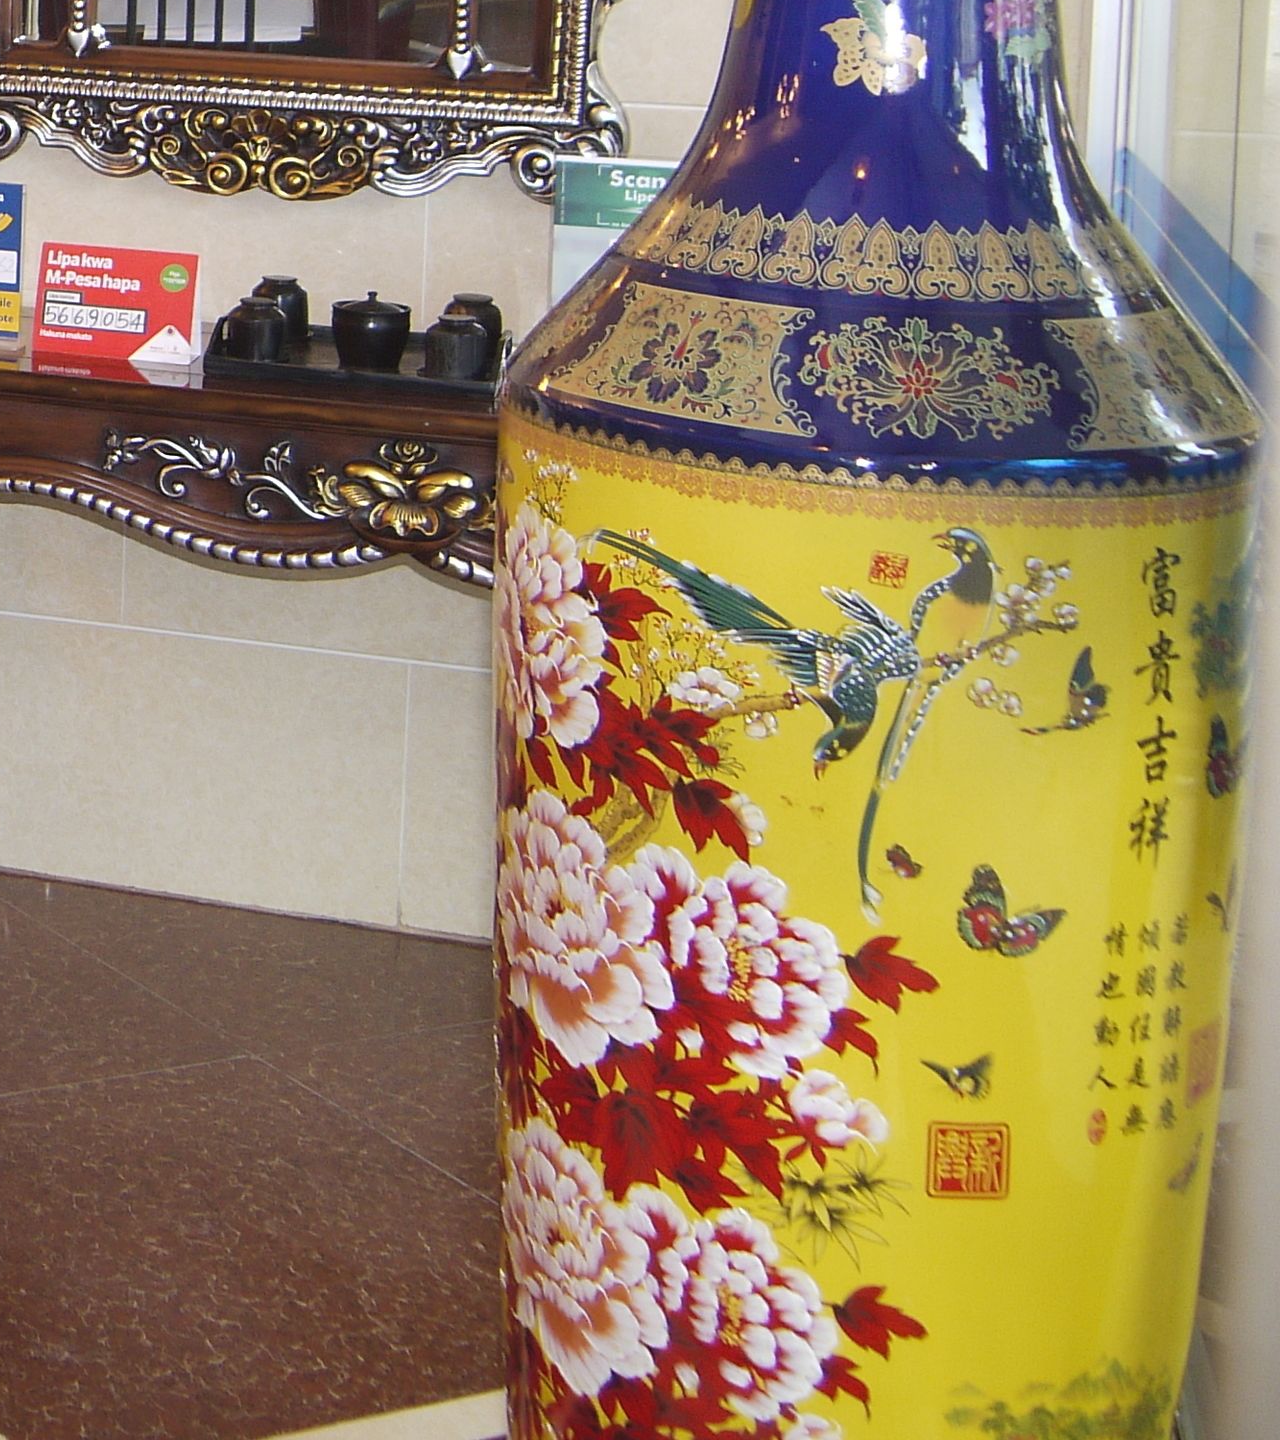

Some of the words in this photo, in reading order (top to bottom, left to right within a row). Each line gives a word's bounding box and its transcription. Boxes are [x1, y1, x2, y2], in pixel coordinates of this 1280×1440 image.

[610, 169, 666, 189] Scan
[47, 250, 81, 269] Lipa
[81, 252, 114, 270] kwa
[44, 268, 102, 289] M-Pesa
[102, 273, 142, 294] hapa
[0, 297, 13, 308] ile
[45, 305, 144, 332] 5669054
